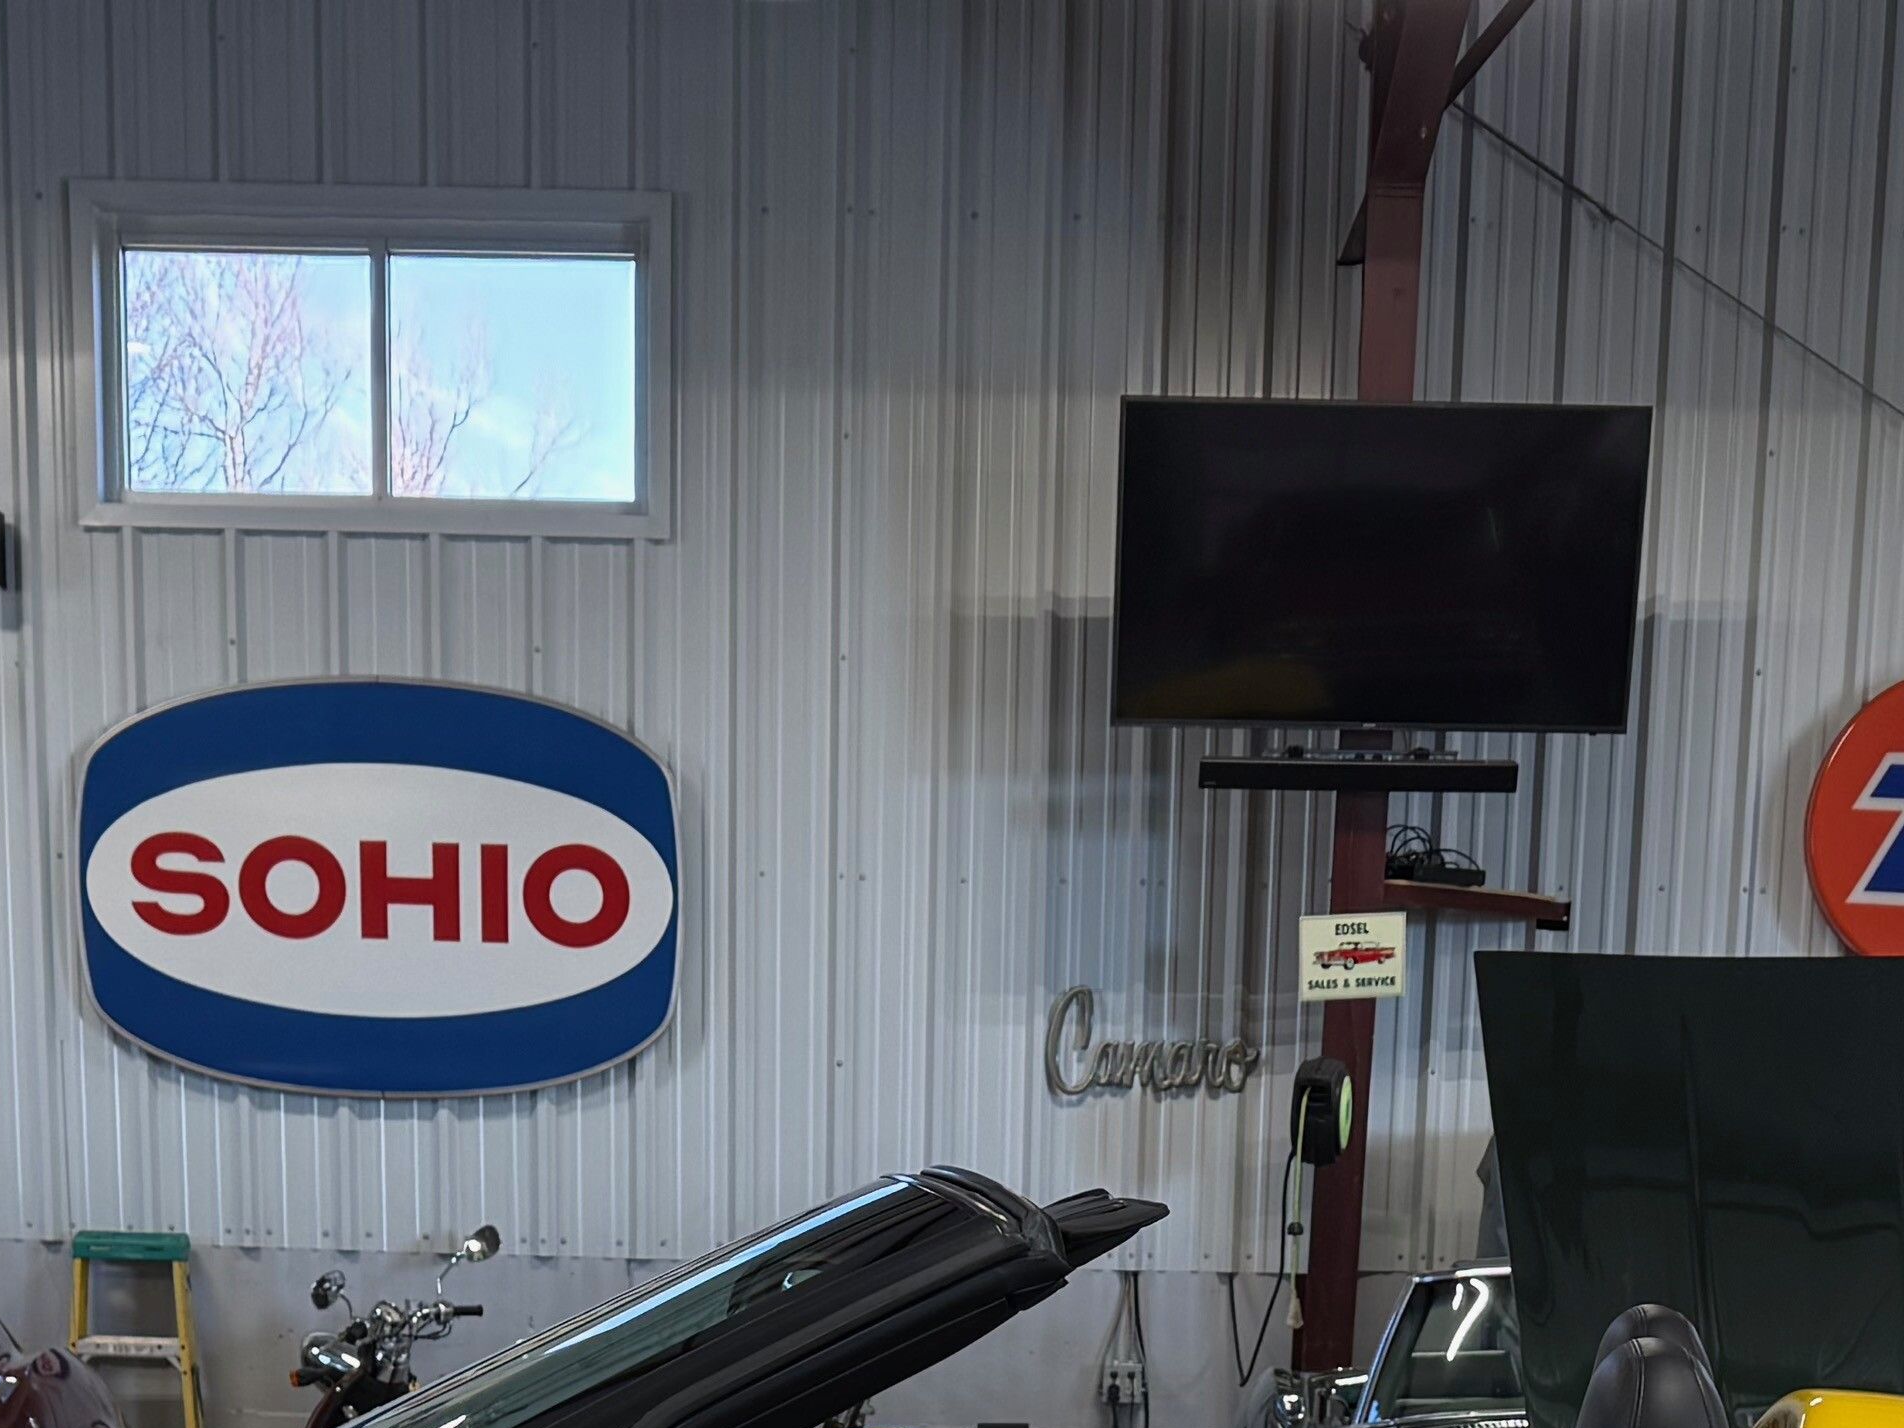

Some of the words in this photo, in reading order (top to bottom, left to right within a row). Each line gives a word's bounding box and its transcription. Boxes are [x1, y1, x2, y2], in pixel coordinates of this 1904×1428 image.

[130, 830, 631, 949] SOHIO
[1334, 921, 1370, 936] EDSEL
[1307, 978, 1339, 991] SALES
[1343, 977, 1351, 989] &
[1355, 975, 1397, 988] SERVICE
[1044, 984, 1261, 1096] Camaro
